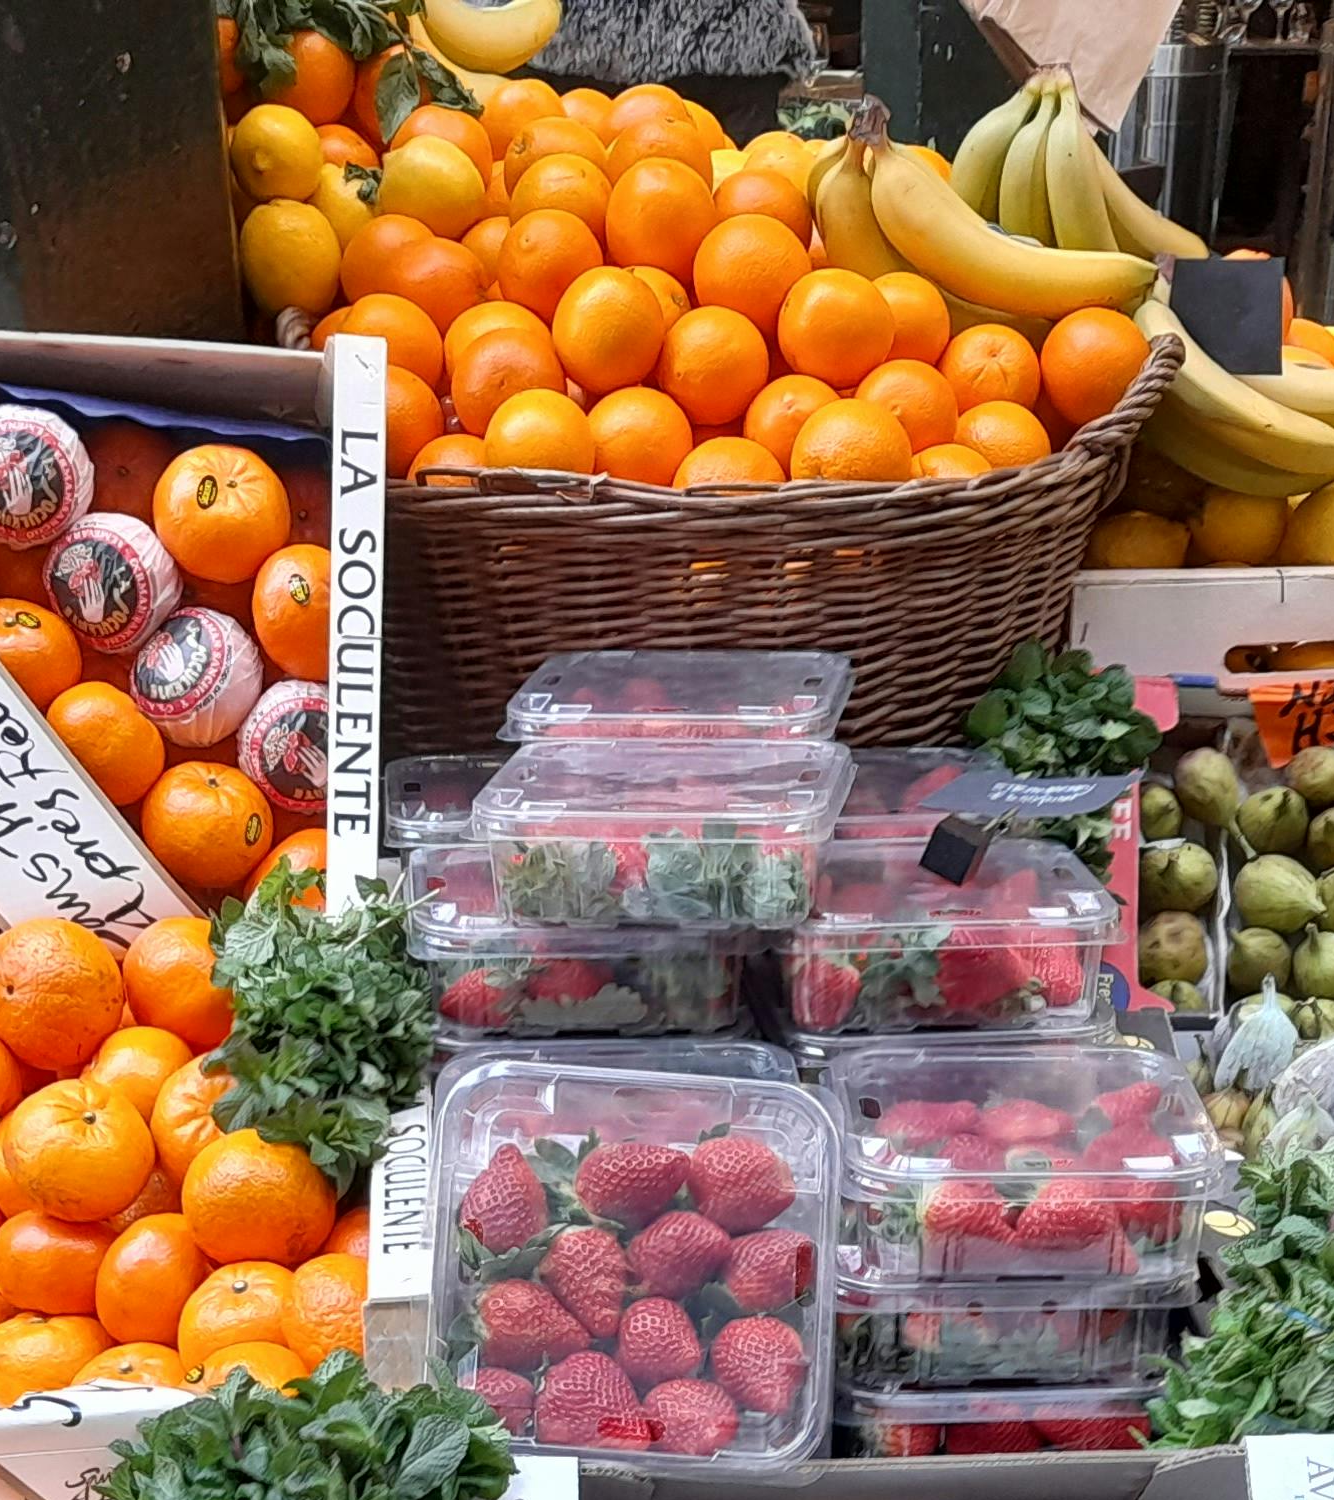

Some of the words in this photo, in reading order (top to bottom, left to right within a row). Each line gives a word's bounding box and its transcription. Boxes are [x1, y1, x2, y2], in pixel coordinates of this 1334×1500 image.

[341, 429, 378, 496] LA
[334, 528, 377, 836] SOCULENTE
[383, 1124, 427, 1254] SOCULENTE
